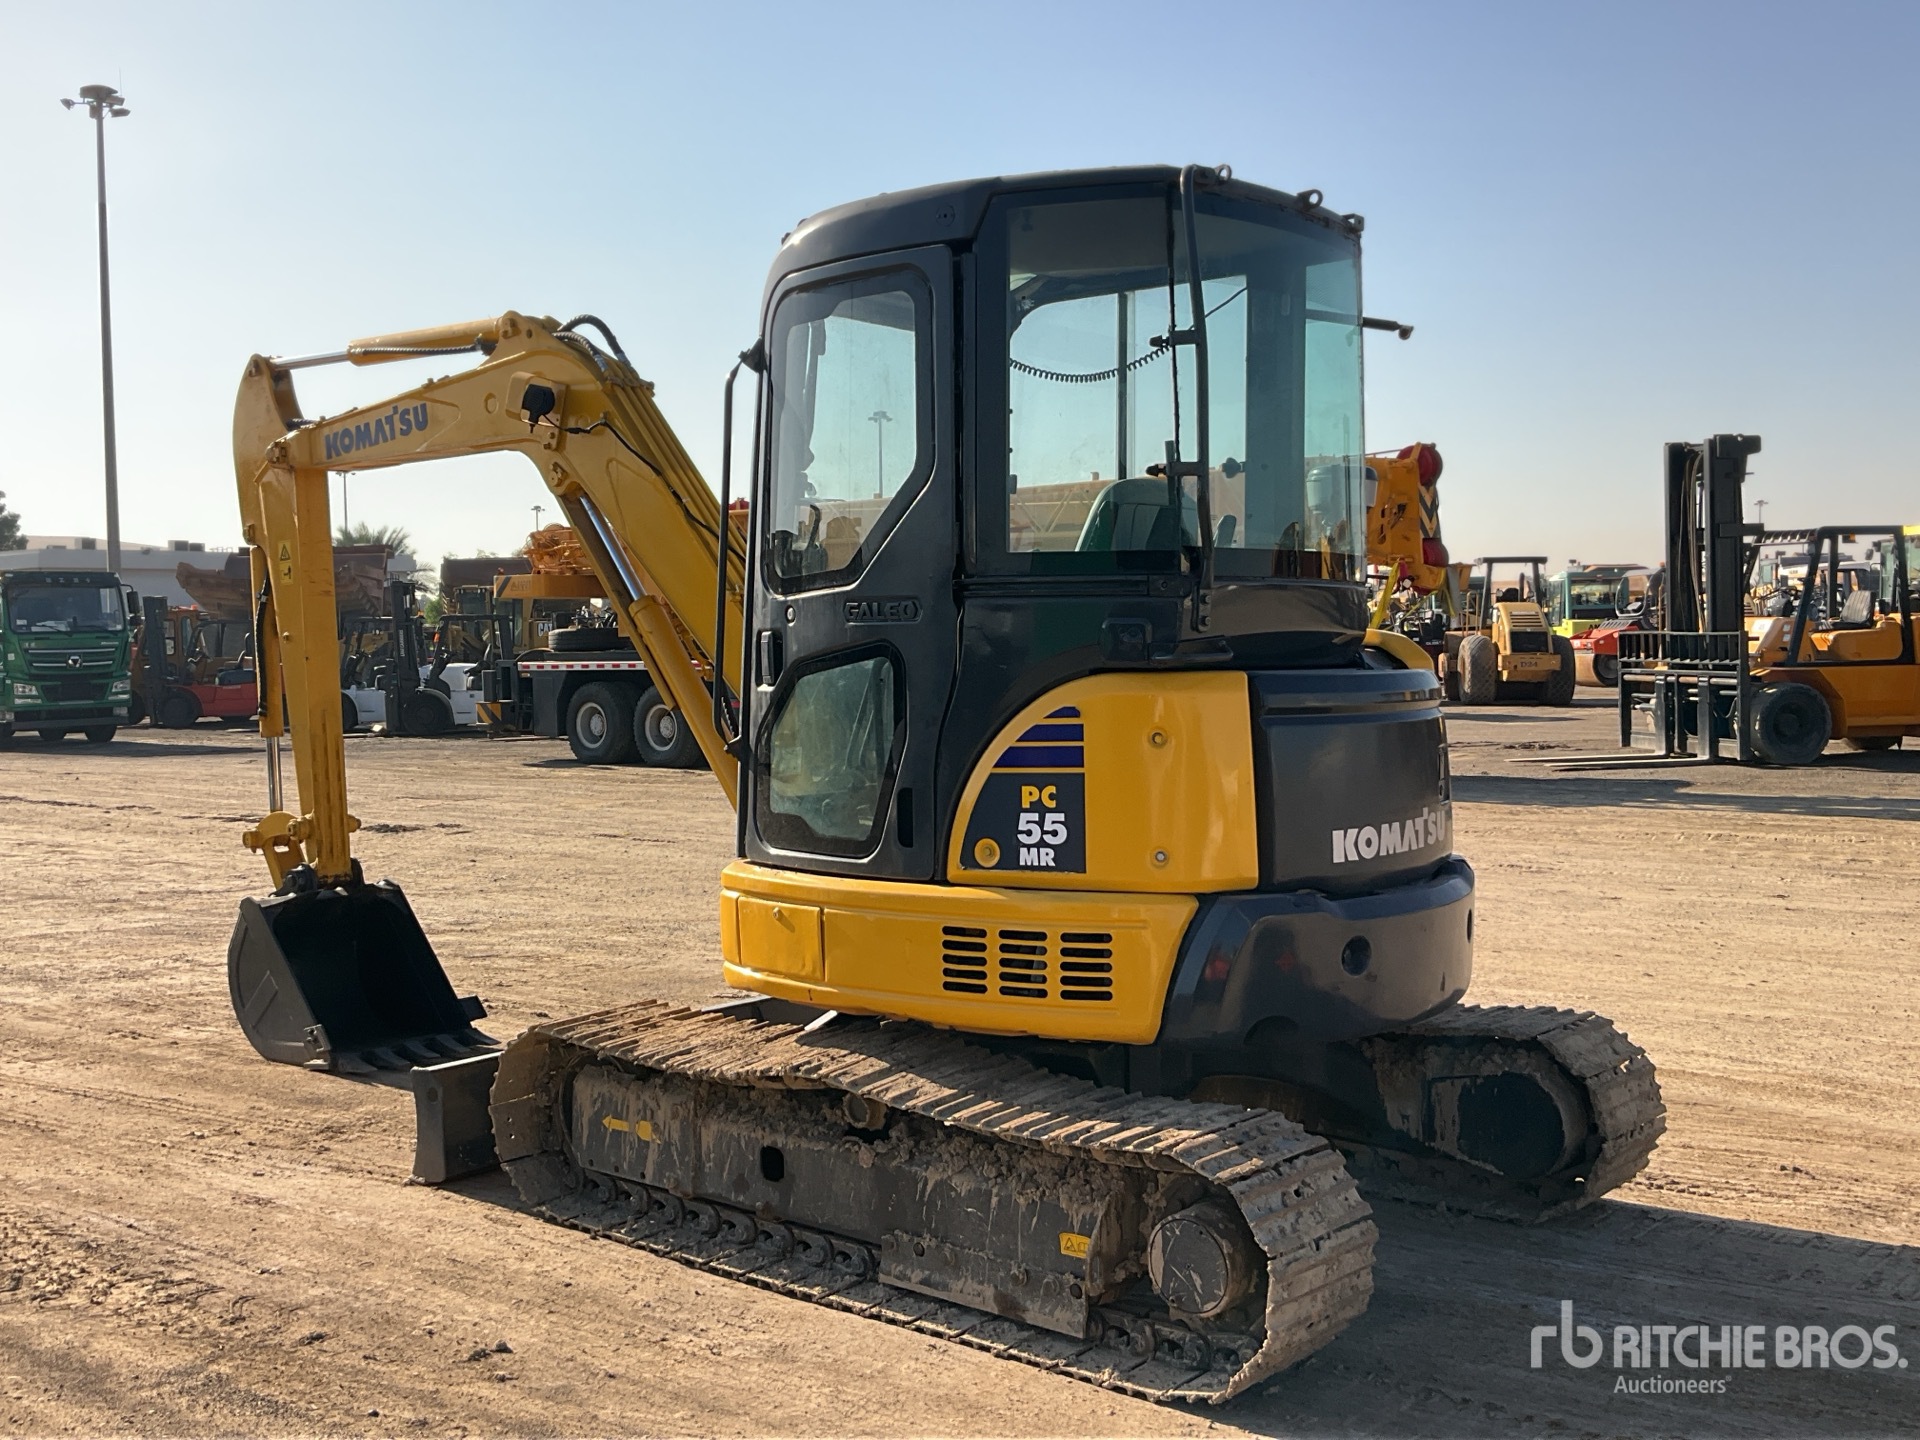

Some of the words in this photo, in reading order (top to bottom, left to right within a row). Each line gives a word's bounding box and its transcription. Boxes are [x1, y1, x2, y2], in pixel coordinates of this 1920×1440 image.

[325, 403, 428, 460] KOMATSU
[844, 601, 921, 619] GALEO
[1021, 785, 1057, 808] PC
[1017, 812, 1067, 845] 55
[1332, 807, 1445, 863] KOMATSU
[1019, 847, 1055, 866] MR
